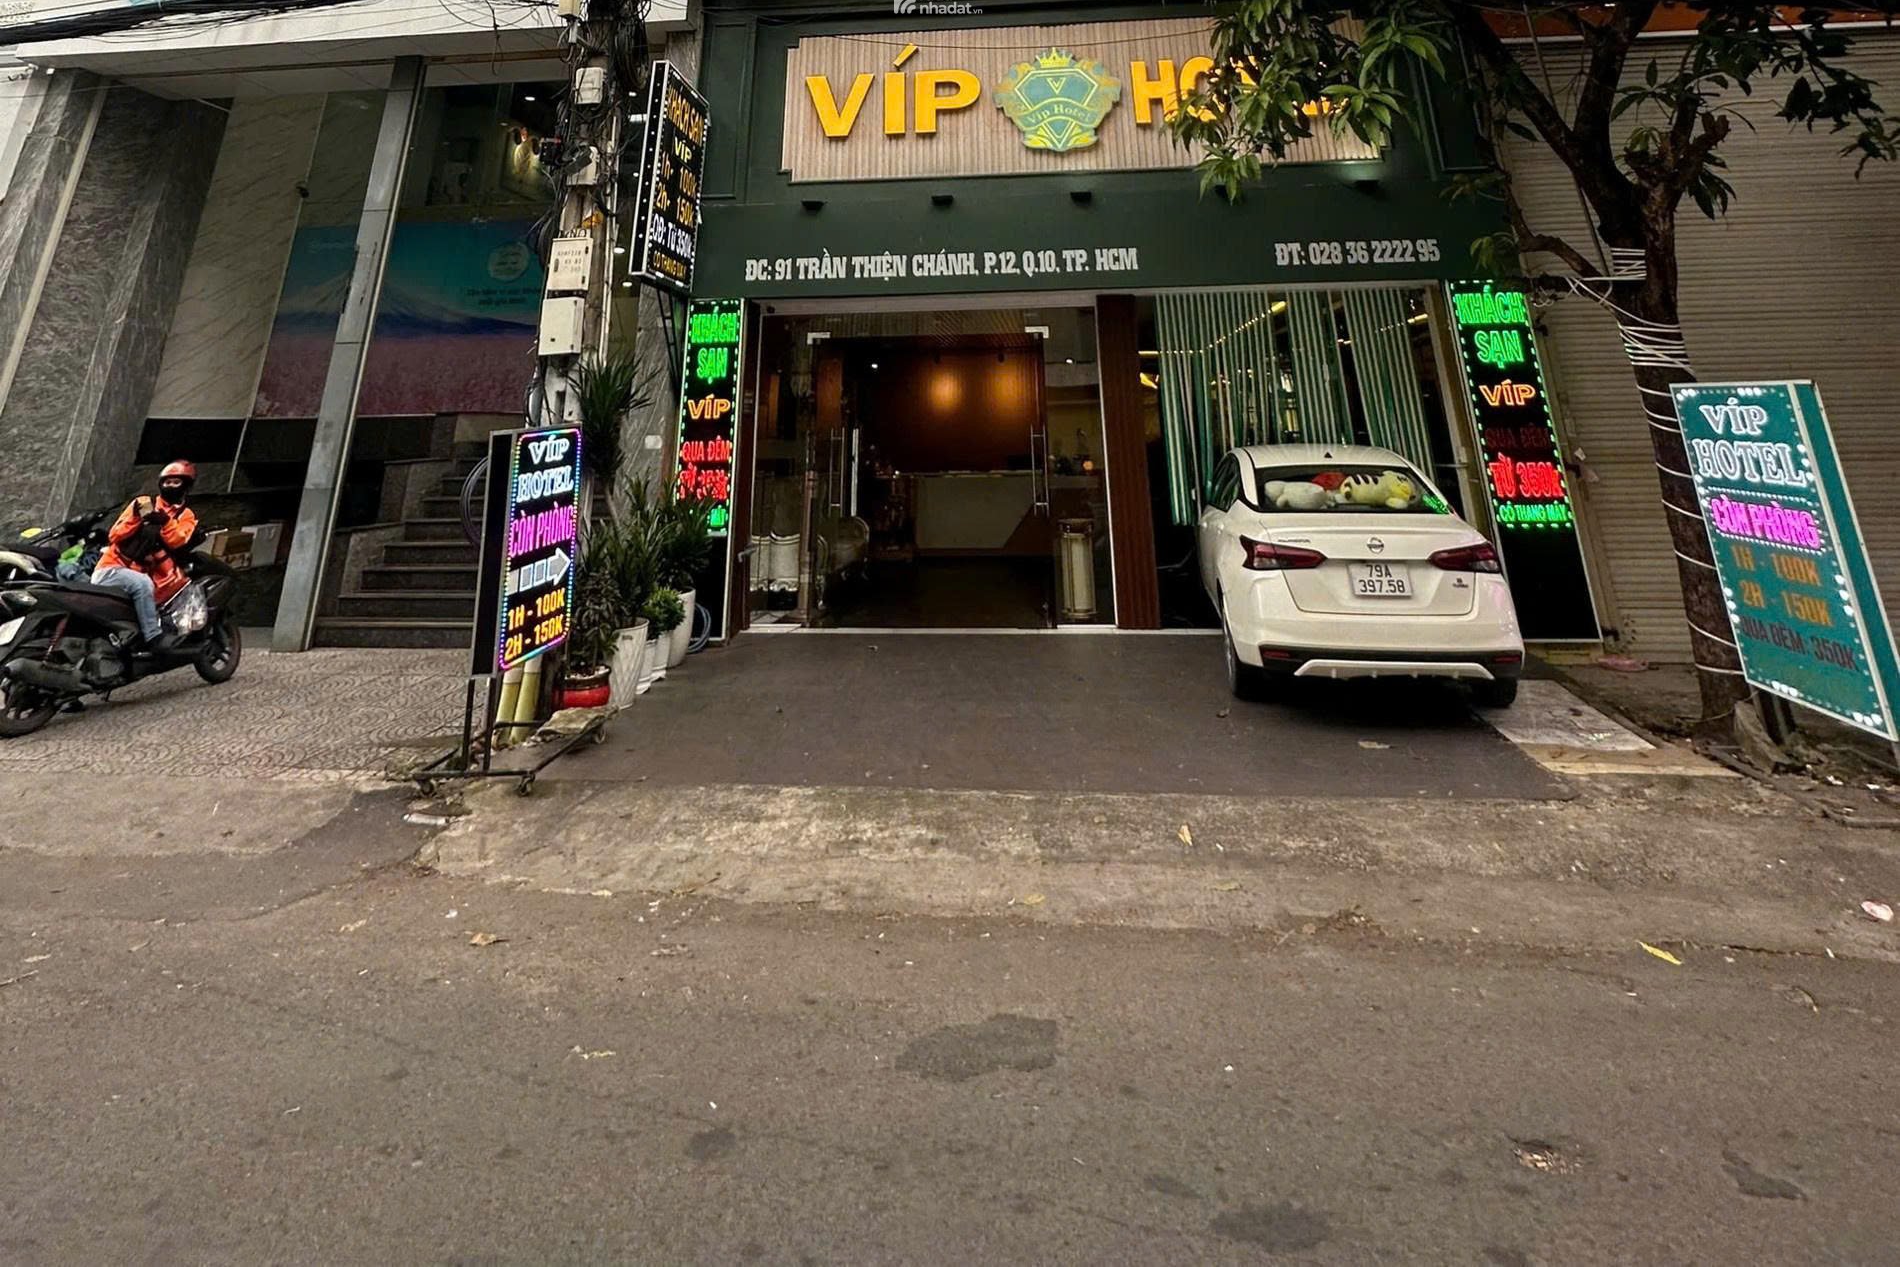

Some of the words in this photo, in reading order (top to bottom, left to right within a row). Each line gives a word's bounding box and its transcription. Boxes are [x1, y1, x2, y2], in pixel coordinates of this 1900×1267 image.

[806, 43, 981, 138] VÍP
[745, 259, 772, 281] ĐC:
[774, 257, 792, 280] 91
[796, 247, 848, 279] TRẦN
[851, 250, 907, 281] THIỆN
[1062, 249, 1089, 272] TP.
[1094, 247, 1139, 271] HCM
[1274, 242, 1306, 266] ĐT:
[1308, 241, 1343, 265] 028
[1455, 285, 1526, 324] KHÁCH
[691, 306, 737, 344] KHÁCH
[697, 347, 729, 384] SẠN
[1474, 329, 1524, 369] SẠN
[687, 393, 731, 420] VÍP
[1479, 379, 1537, 406] VÍP
[1700, 398, 1768, 434] VÍP
[528, 435, 570, 465] VÍP
[682, 441, 705, 462] QUA
[707, 435, 731, 462] ĐÊM
[1693, 438, 1807, 487] HOTEL
[516, 465, 574, 503] HOTEL
[509, 510, 536, 558] CÒN
[535, 501, 574, 550] PHÒNG
[1711, 494, 1752, 537] CÒN
[1747, 500, 1821, 549] PHÒNG
[1358, 579, 1406, 593] 397.58
[1366, 564, 1392, 578] 79A
[507, 604, 526, 632] 1H
[536, 587, 566, 617] 100K
[504, 633, 523, 661] 2H
[534, 614, 563, 644] 150K
